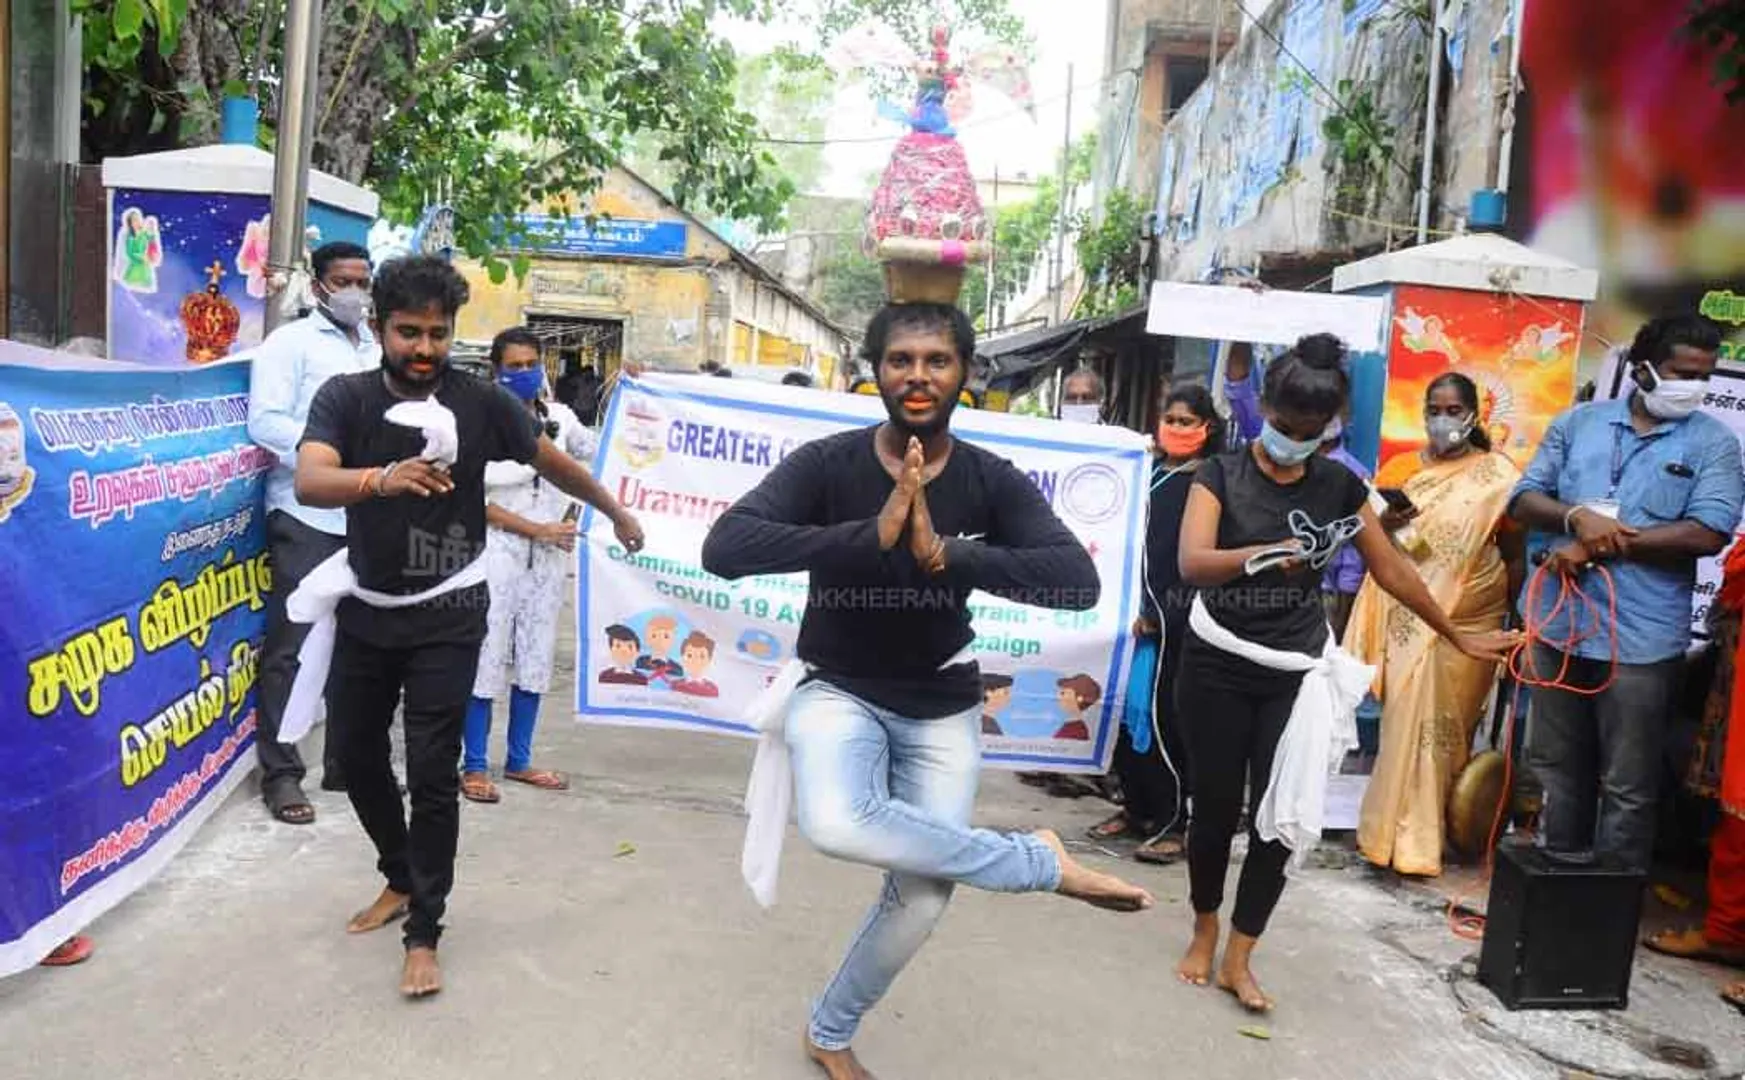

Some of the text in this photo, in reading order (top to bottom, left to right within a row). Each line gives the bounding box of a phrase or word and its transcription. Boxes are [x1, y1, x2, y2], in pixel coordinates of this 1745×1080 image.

[667, 418, 772, 467] GREATER
[655, 579, 731, 613] COVID
[742, 597, 770, 619] 19
[28, 614, 136, 716] சமூக
[119, 656, 224, 786] செயல்
